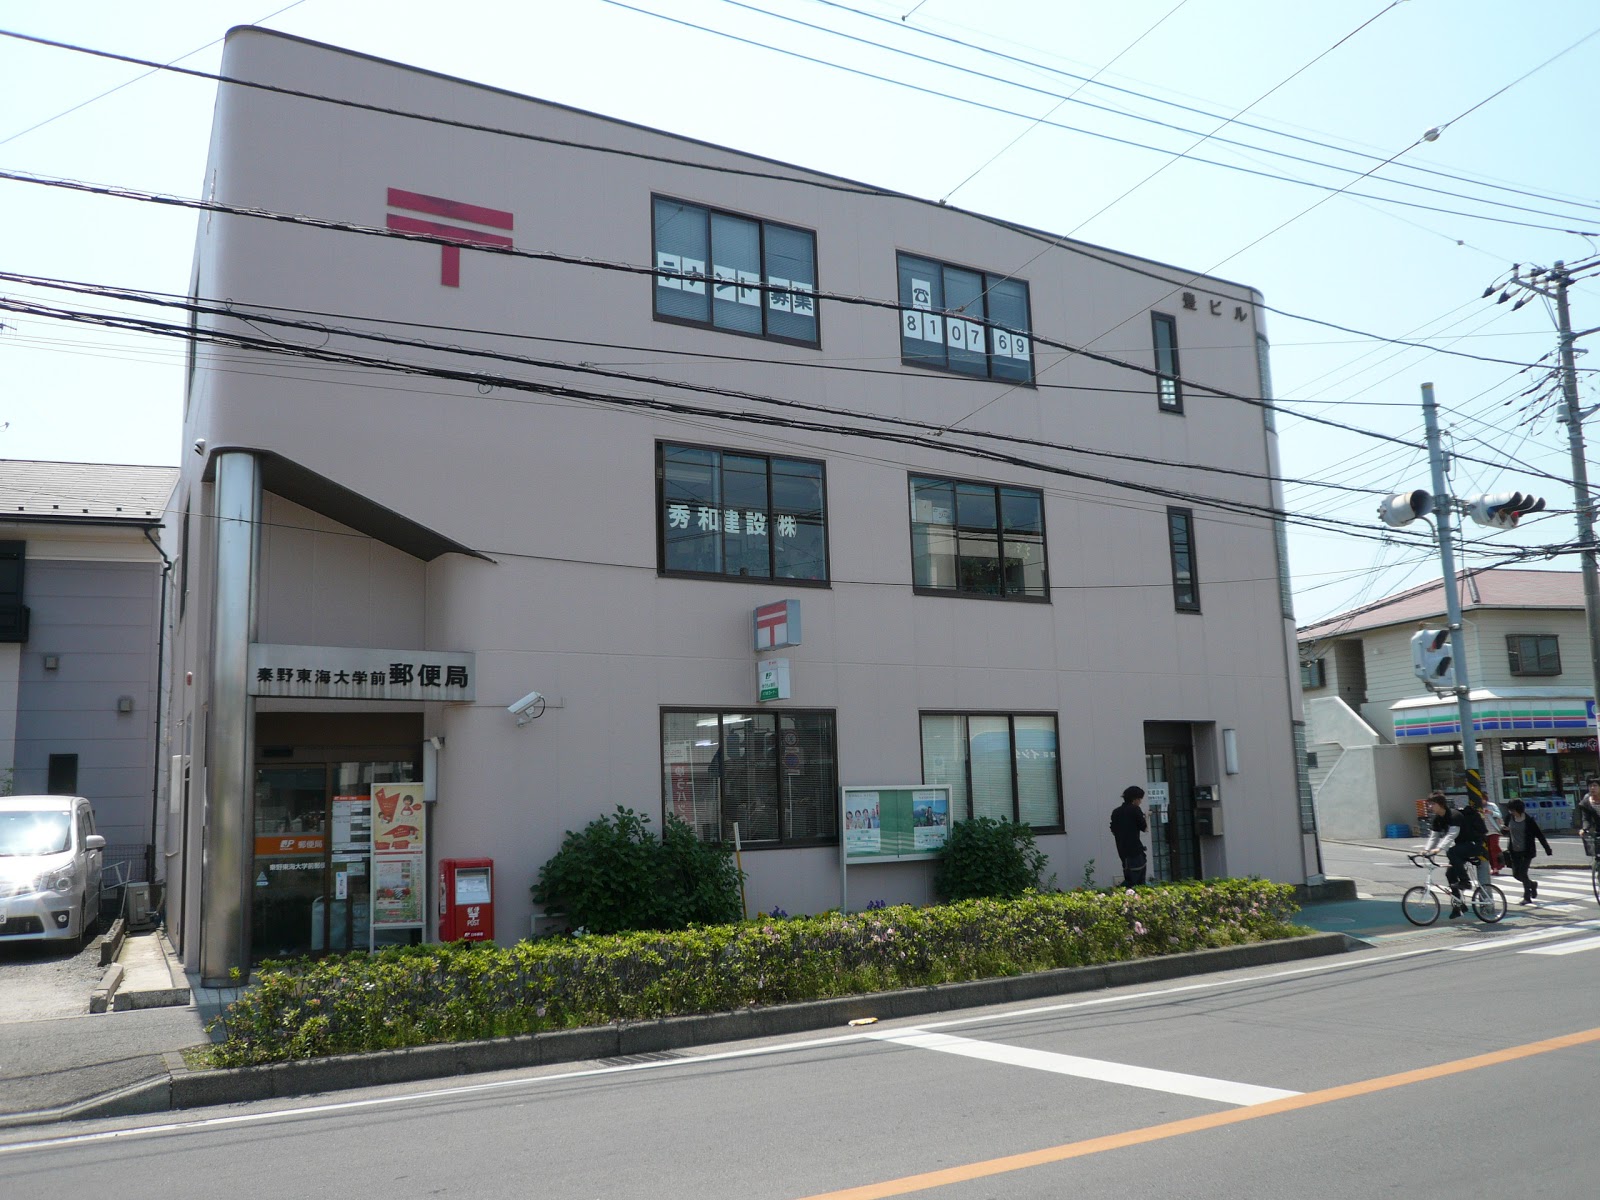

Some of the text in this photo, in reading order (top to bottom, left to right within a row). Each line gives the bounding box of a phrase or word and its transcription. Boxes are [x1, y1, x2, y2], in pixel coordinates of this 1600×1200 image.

[661, 261, 813, 311] テナント募集
[466, 919, 480, 927] POST
